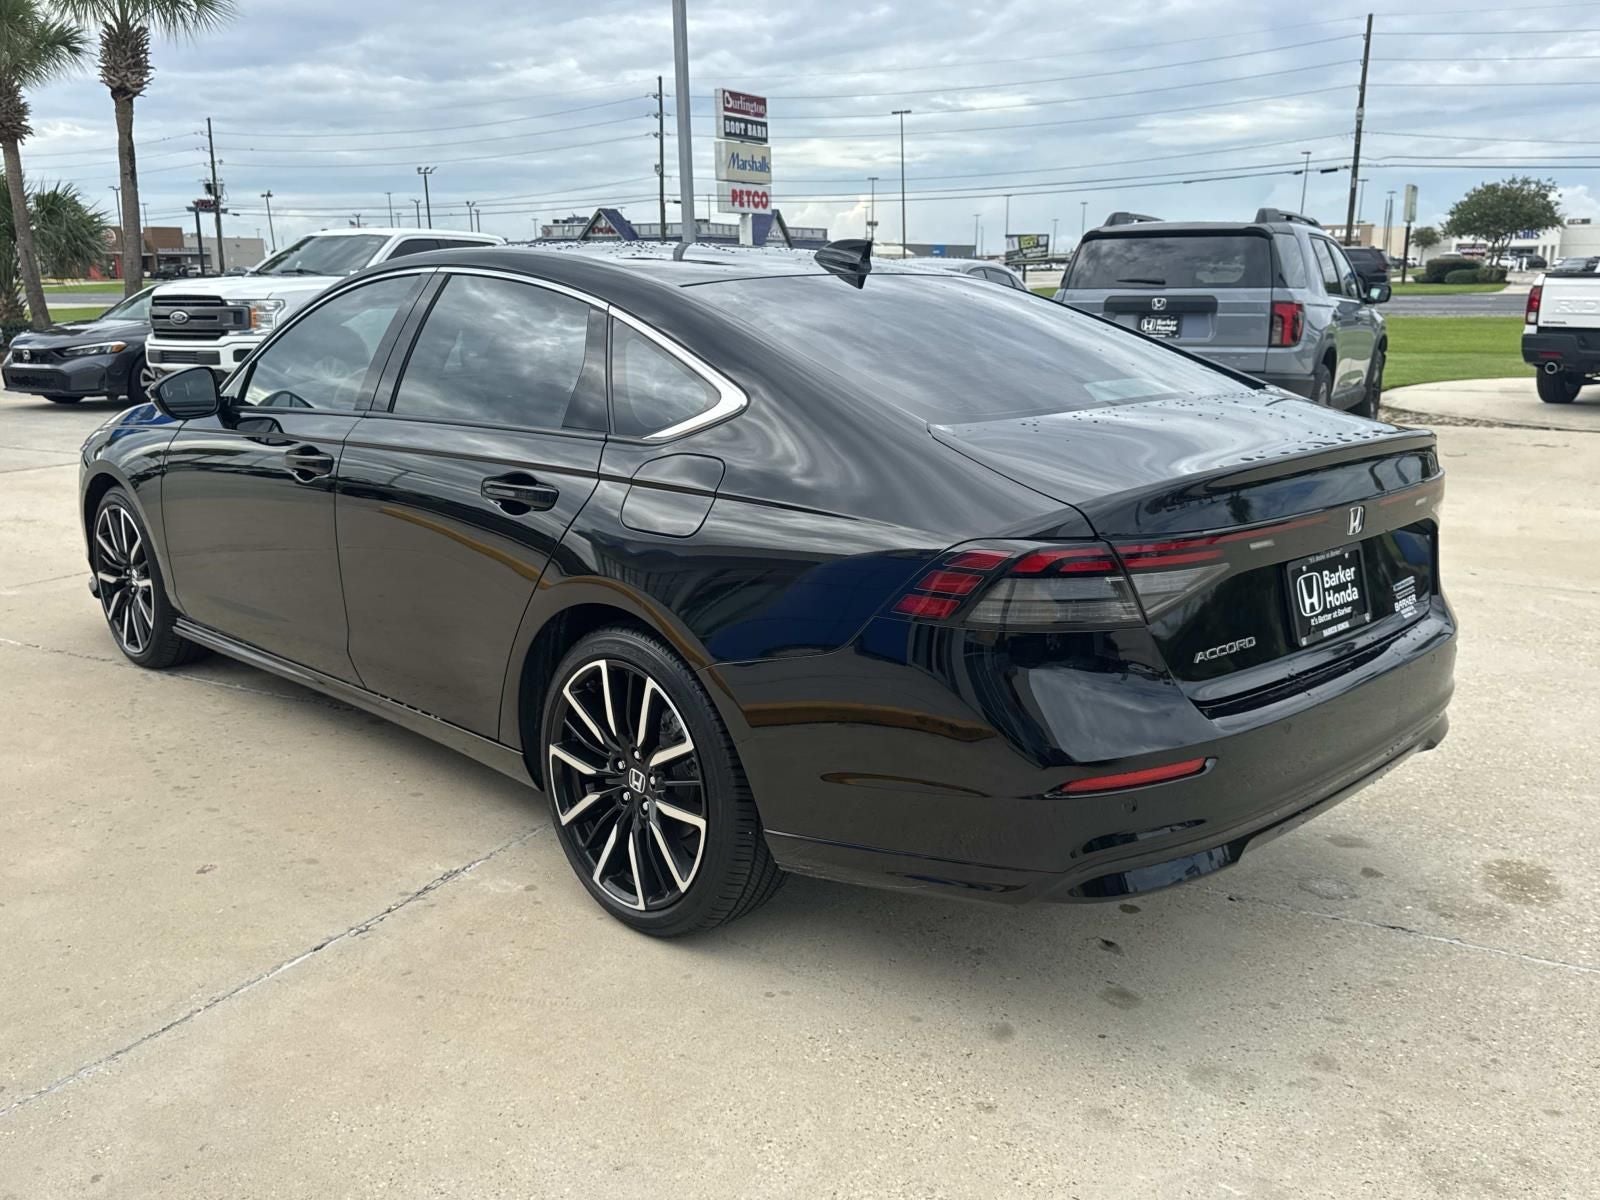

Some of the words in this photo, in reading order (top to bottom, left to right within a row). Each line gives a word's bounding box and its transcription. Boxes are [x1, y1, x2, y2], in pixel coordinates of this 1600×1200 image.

[724, 91, 766, 114] Burlington
[725, 119, 745, 135] BOOT
[747, 123, 767, 138] BARN
[728, 152, 770, 172] Marshalls
[731, 189, 769, 209] PETCO
[1323, 565, 1356, 588] Barker
[1325, 583, 1359, 609] Honda
[1193, 636, 1256, 664] ACCORD
